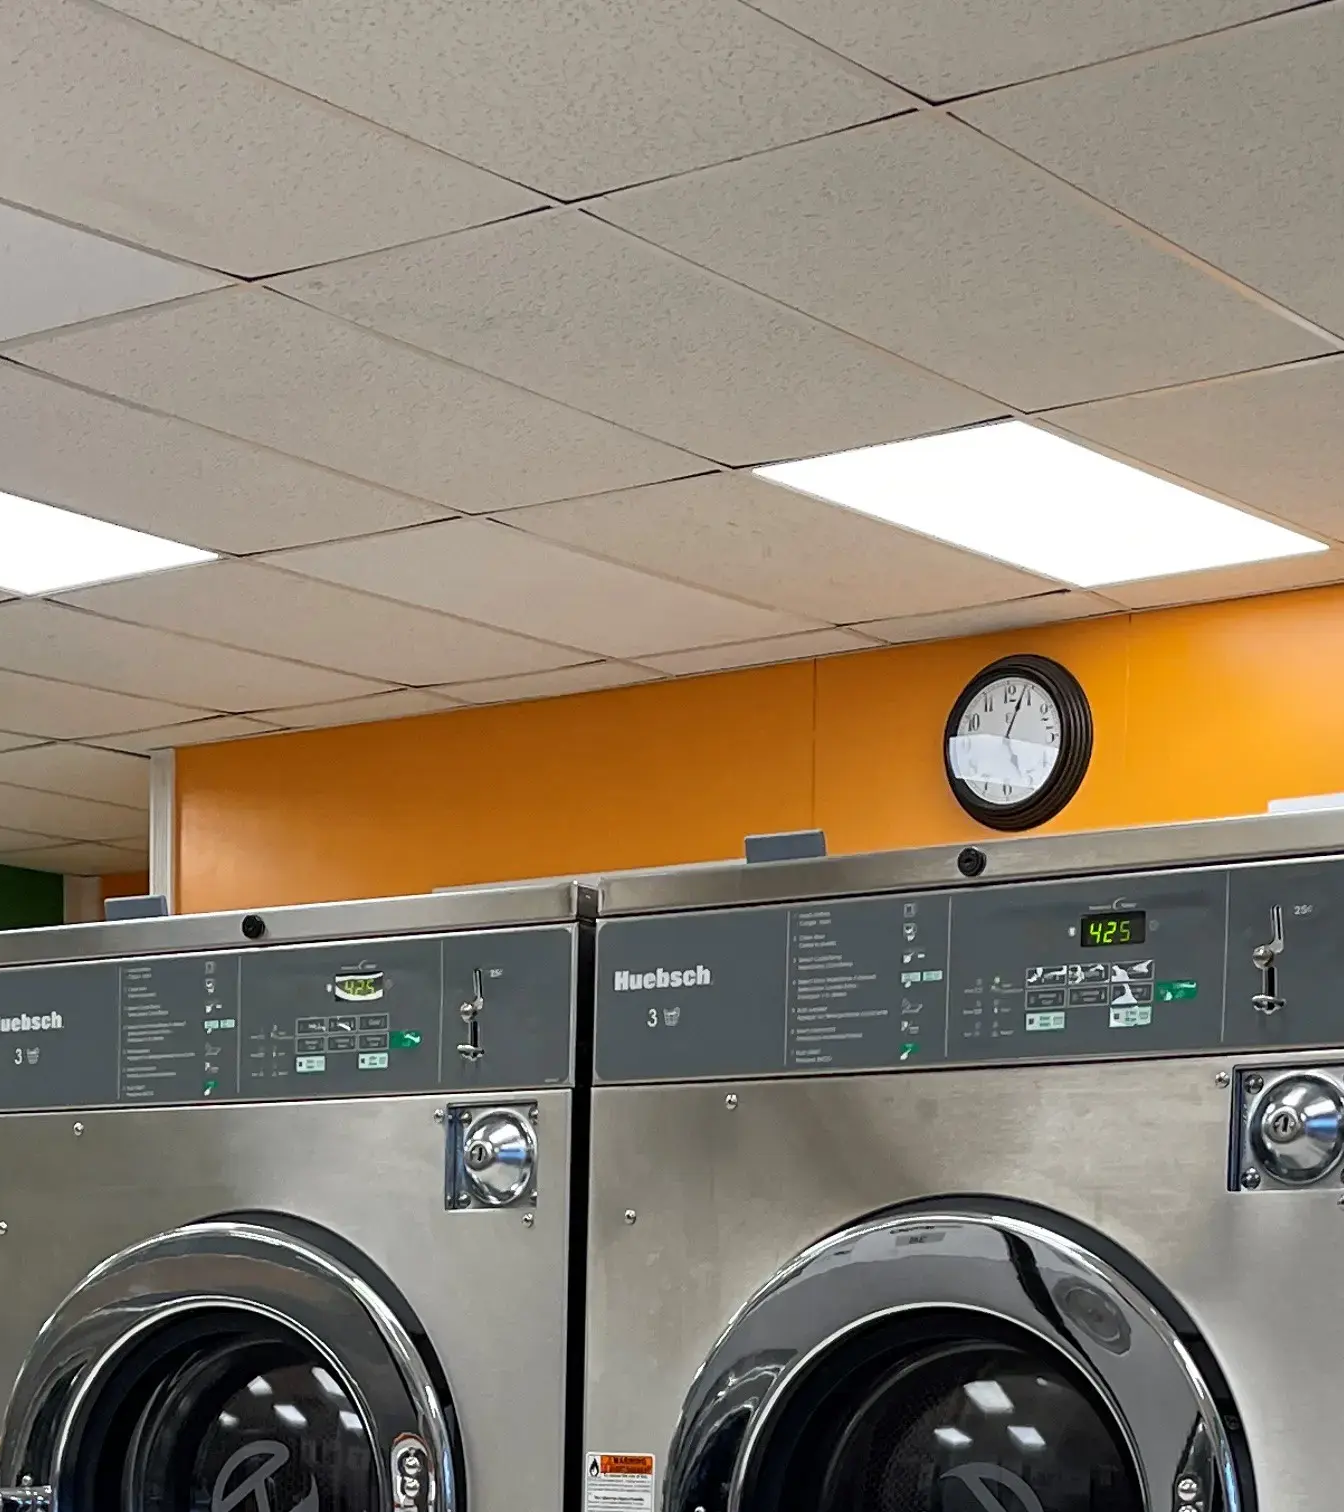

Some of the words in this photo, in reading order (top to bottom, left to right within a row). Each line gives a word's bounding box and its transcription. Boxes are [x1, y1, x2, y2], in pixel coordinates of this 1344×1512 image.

[983, 694, 994, 712] 11
[968, 713, 981, 731] 10
[1089, 920, 1131, 944] 425
[344, 979, 375, 995] 425
[614, 965, 711, 991] Huebsch
[647, 1008, 657, 1028] 3
[14, 1048, 23, 1065] 3
